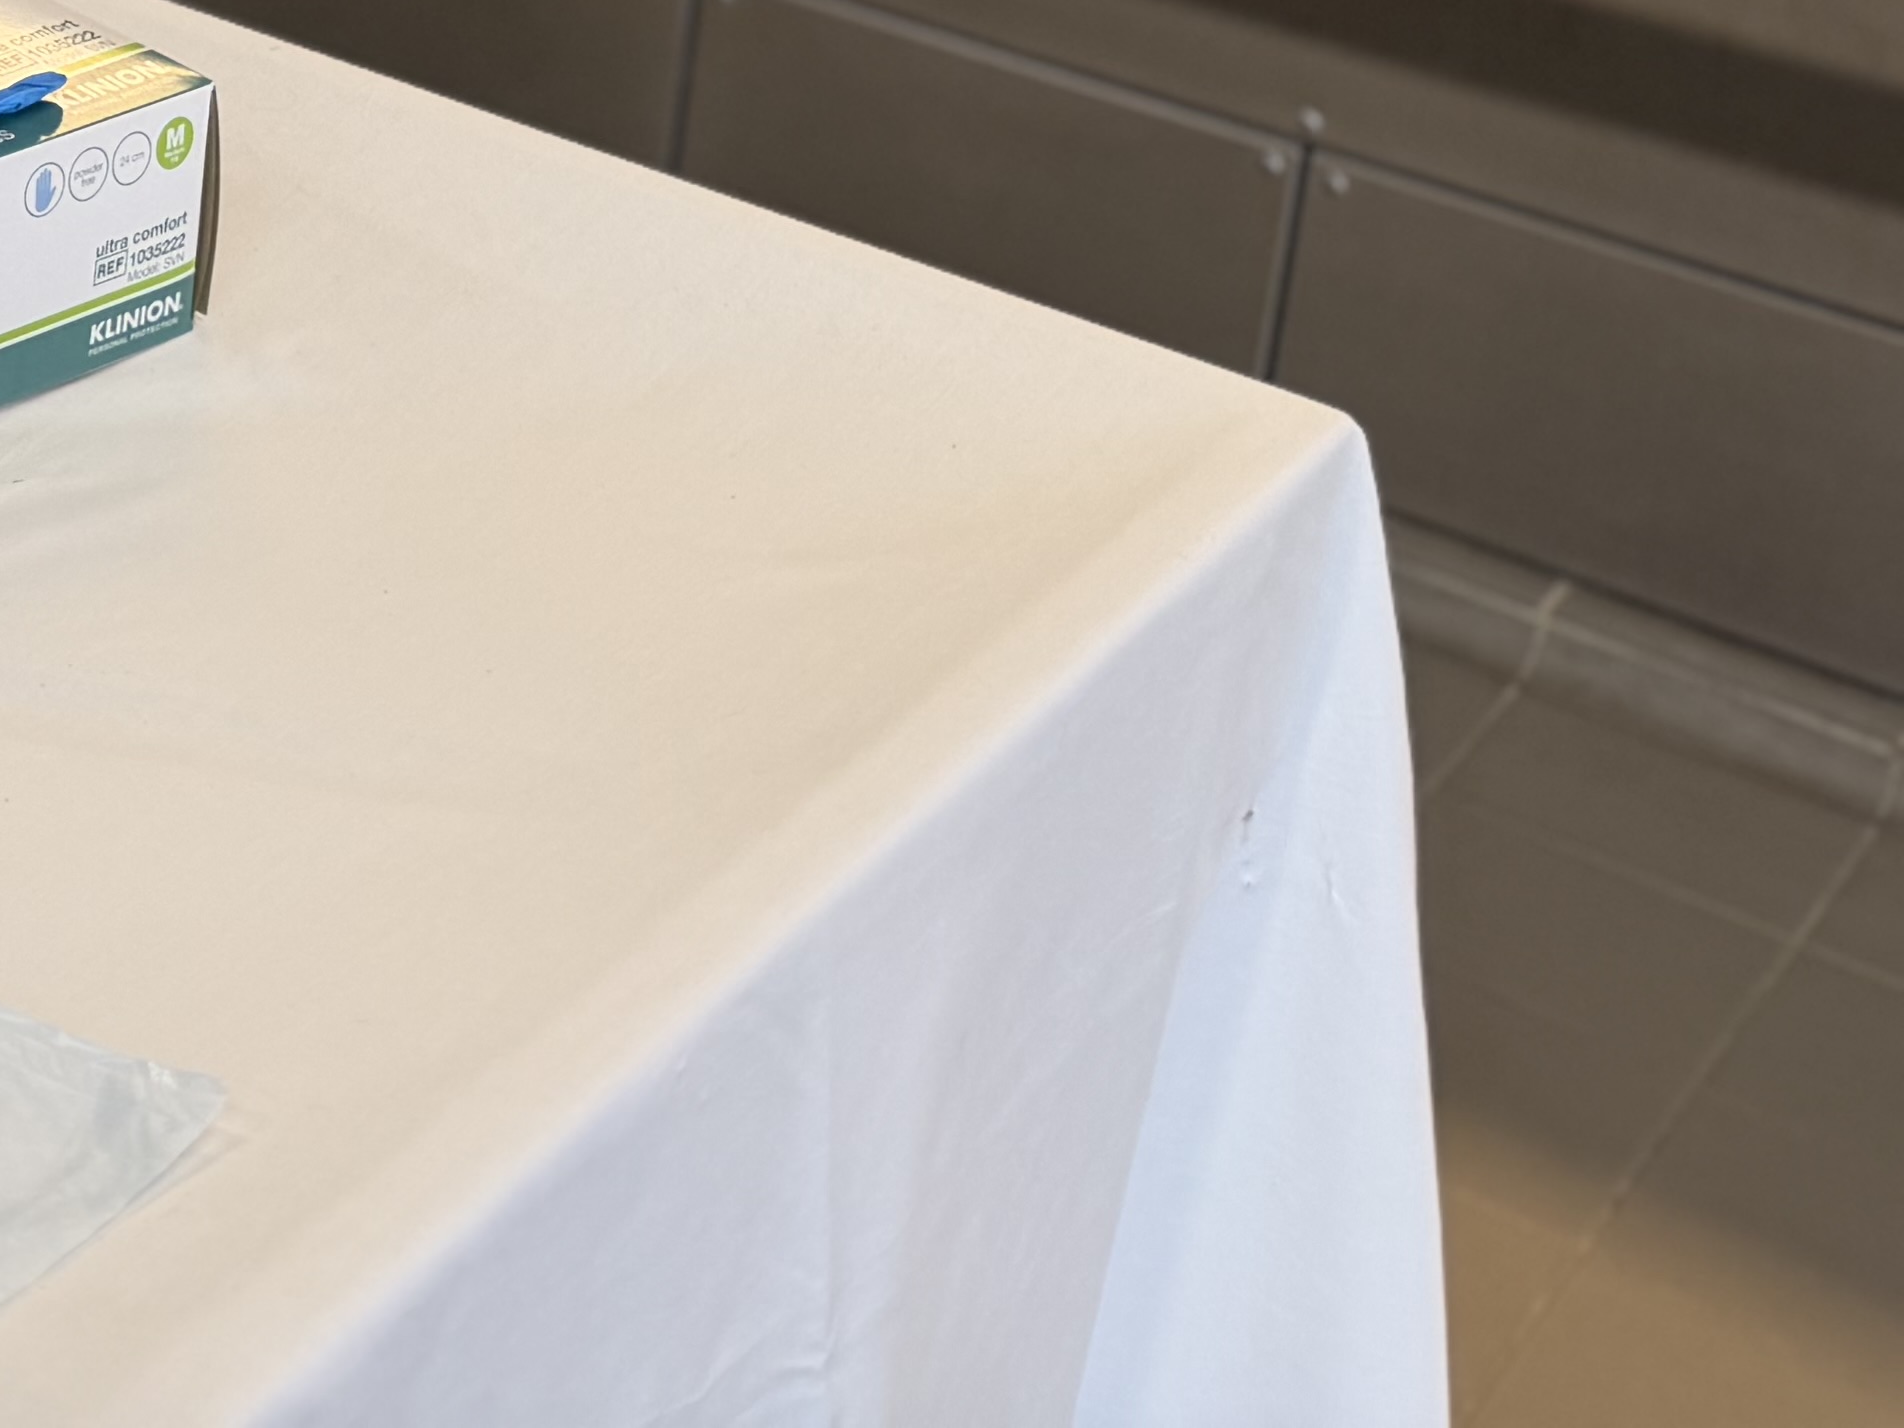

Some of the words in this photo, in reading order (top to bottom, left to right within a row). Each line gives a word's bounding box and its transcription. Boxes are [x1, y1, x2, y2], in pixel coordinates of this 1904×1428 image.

[166, 123, 186, 150] M
[96, 236, 129, 258] ultra
[132, 211, 188, 245] comfort
[97, 256, 124, 279] REF
[129, 232, 186, 267] 1035222
[89, 291, 182, 345] KLINION
